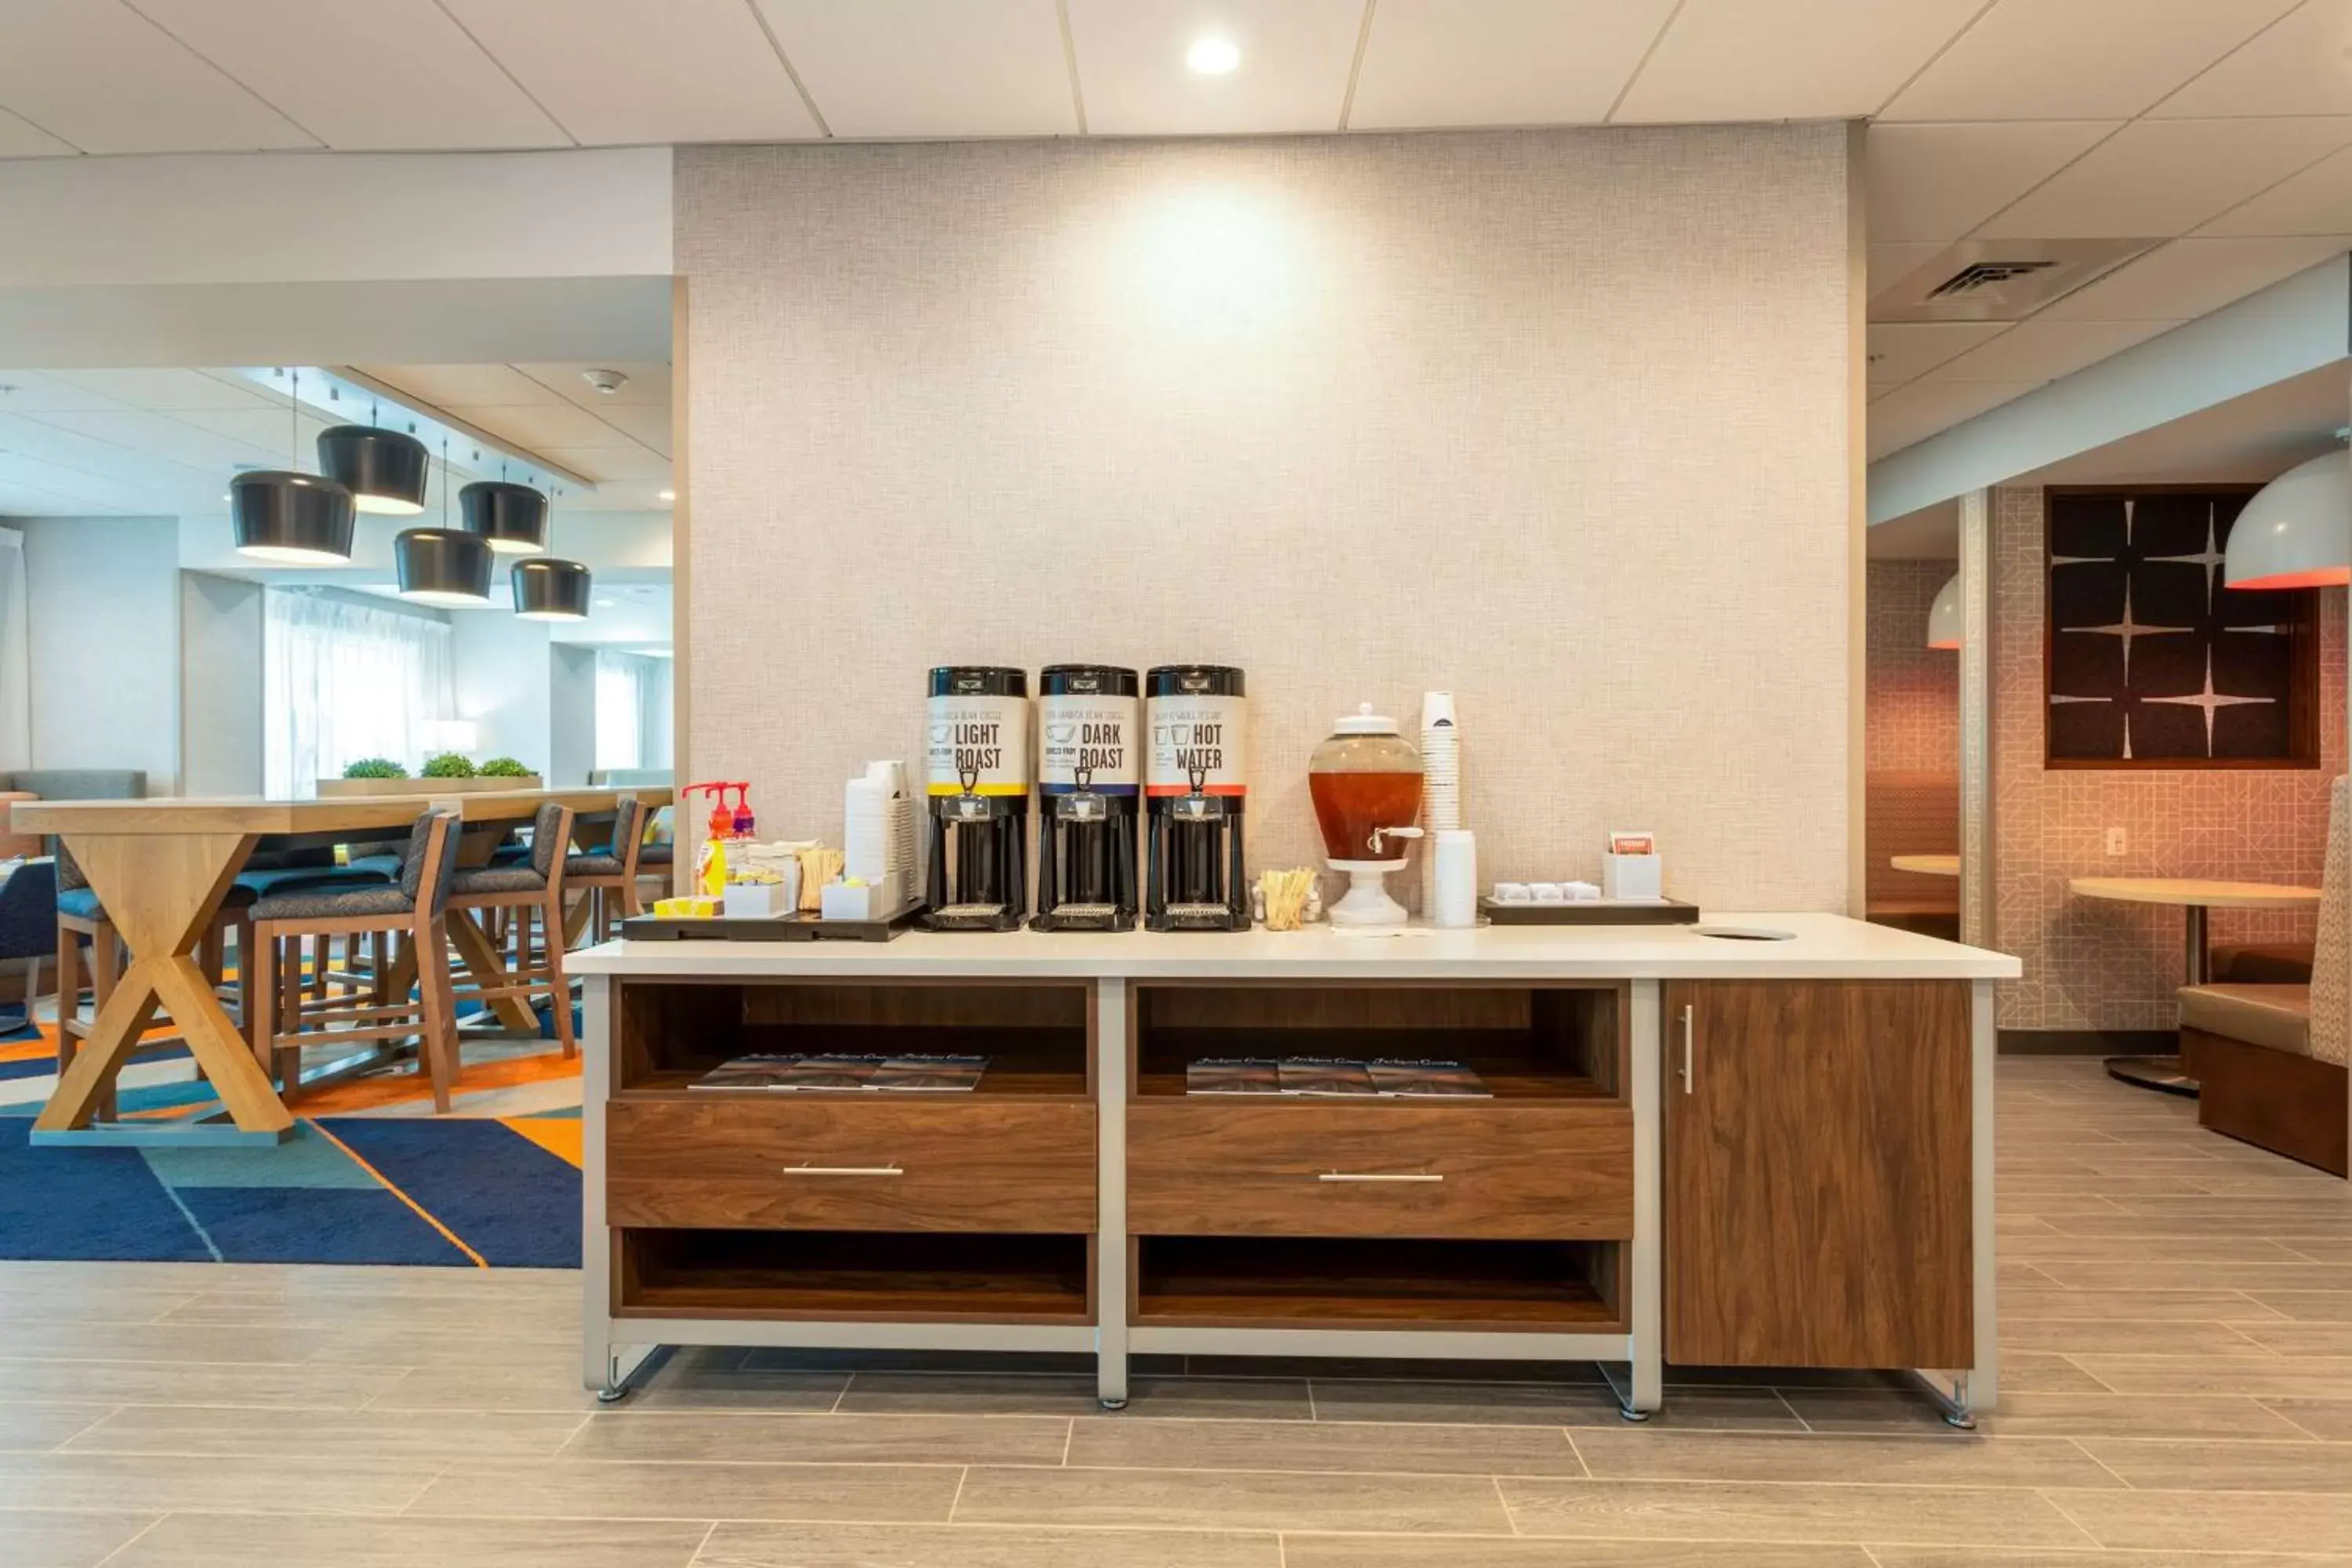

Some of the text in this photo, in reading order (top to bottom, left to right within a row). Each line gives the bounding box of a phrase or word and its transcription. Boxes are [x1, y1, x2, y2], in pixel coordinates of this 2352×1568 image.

[955, 724, 1000, 745] LIGHT
[1082, 724, 1121, 745] DARK
[1193, 724, 1222, 745] HOT
[955, 748, 1002, 769] ROAST
[1079, 747, 1123, 769] ROAST
[1177, 748, 1222, 769] WATER
